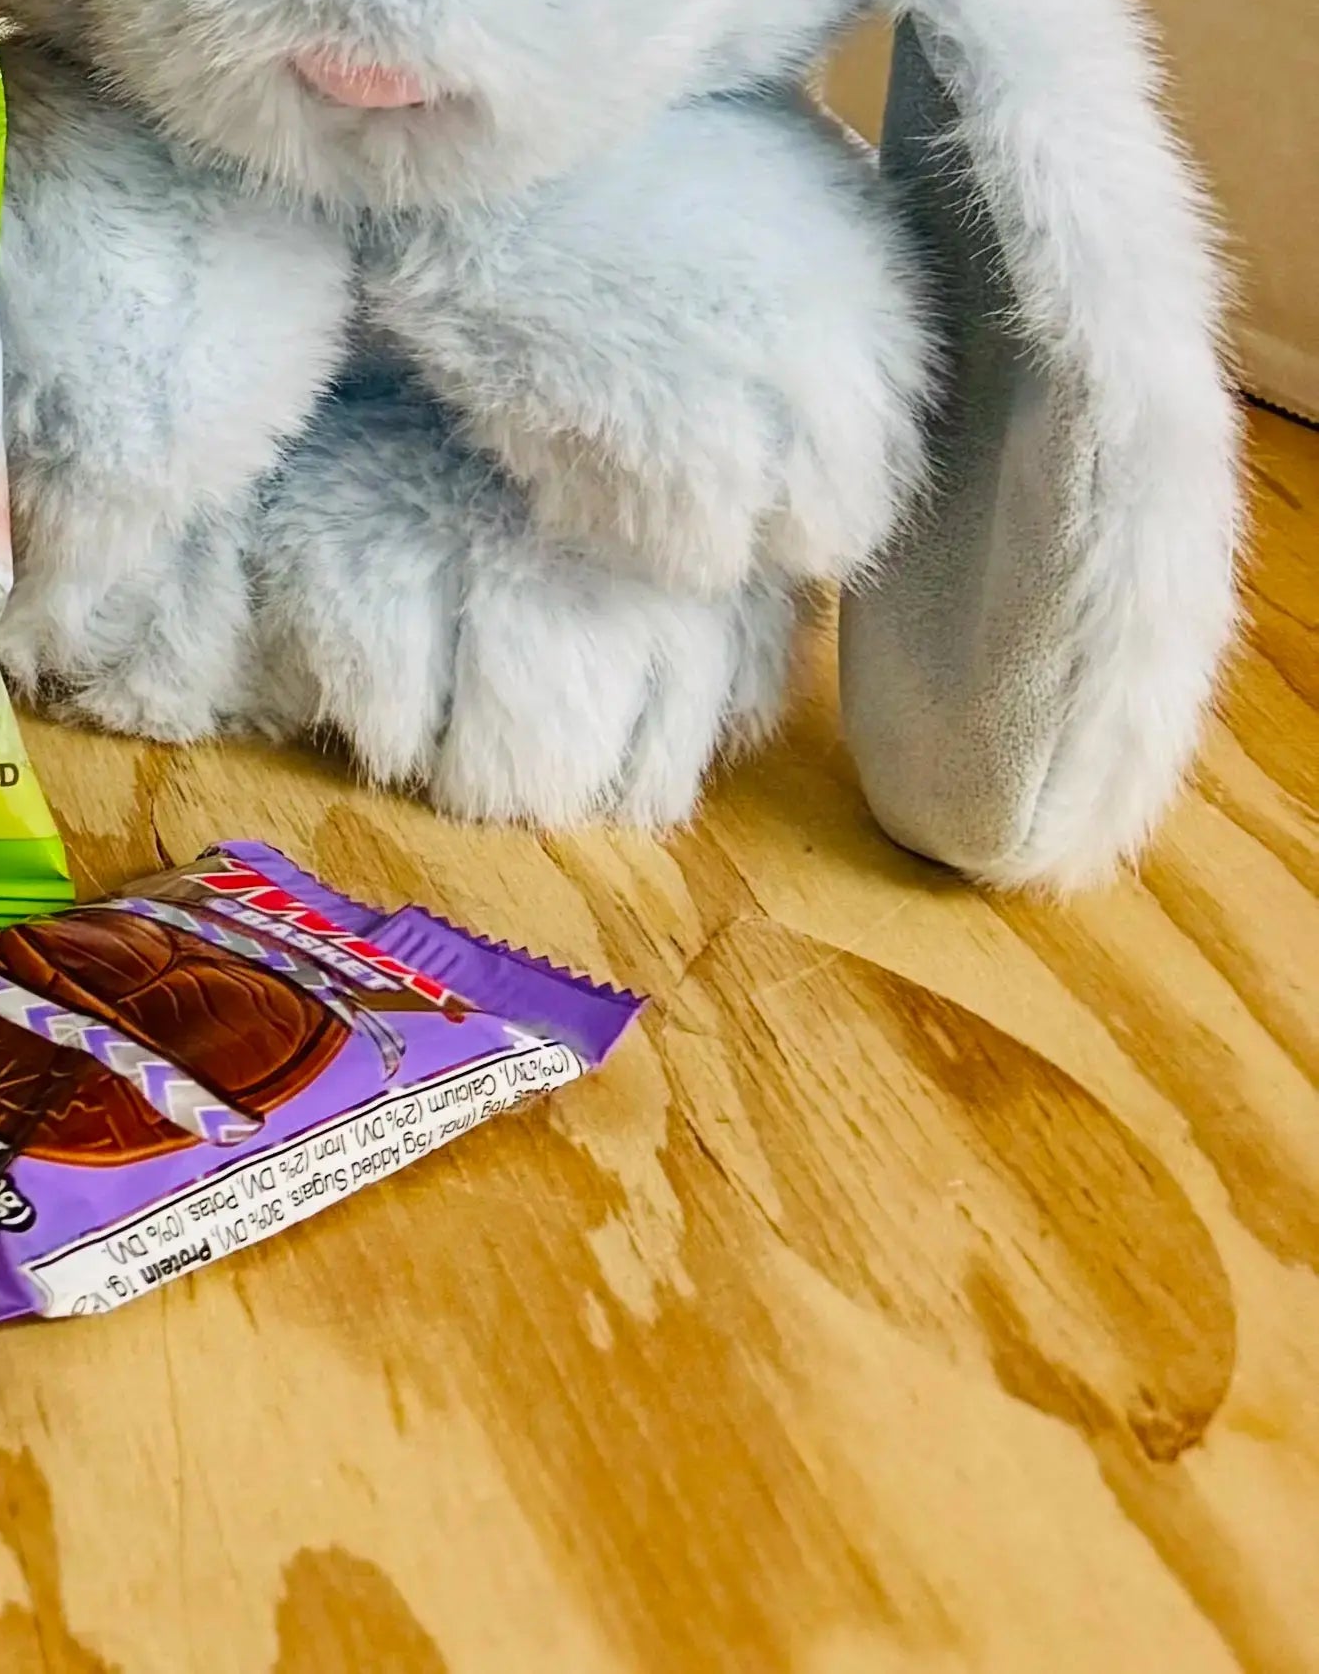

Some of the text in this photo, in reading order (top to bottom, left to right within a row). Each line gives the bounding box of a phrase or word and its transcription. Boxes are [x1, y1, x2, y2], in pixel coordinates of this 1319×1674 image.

[429, 1073, 498, 1114] Calcium
[313, 1136, 346, 1162] Iron
[351, 1146, 402, 1186] Added
[247, 1198, 286, 1232] 30%
[139, 1237, 212, 1285] Protein
